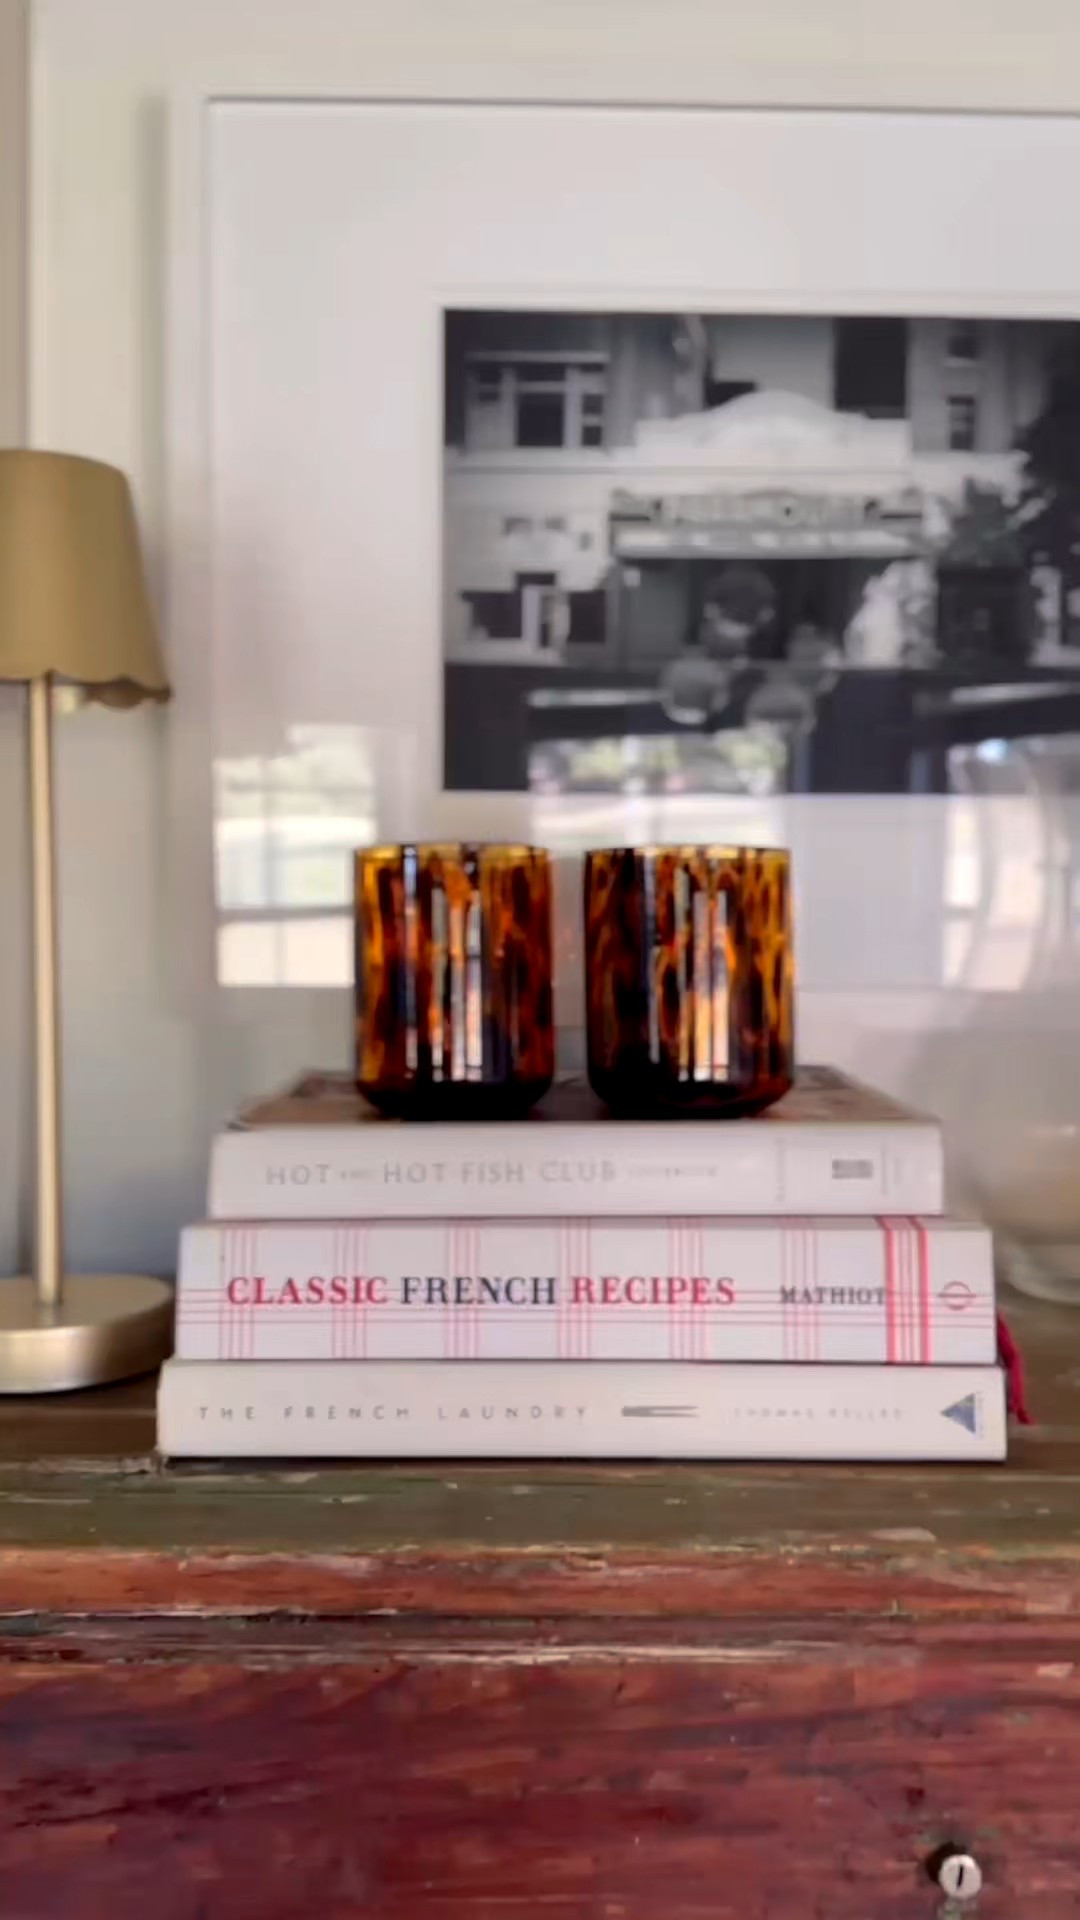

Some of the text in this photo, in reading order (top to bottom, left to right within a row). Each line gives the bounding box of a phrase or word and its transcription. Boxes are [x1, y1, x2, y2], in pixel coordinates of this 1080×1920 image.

[267, 1164, 330, 1185] HOT
[384, 1161, 446, 1184] HOT
[462, 1161, 525, 1184] FISH
[540, 1160, 617, 1183] CLUB
[227, 1276, 735, 1305] CLASSIC FRENCH RECIPES
[780, 1286, 887, 1306] MATHIOT
[199, 1405, 586, 1421] THE FRENCH LAUNDRY
